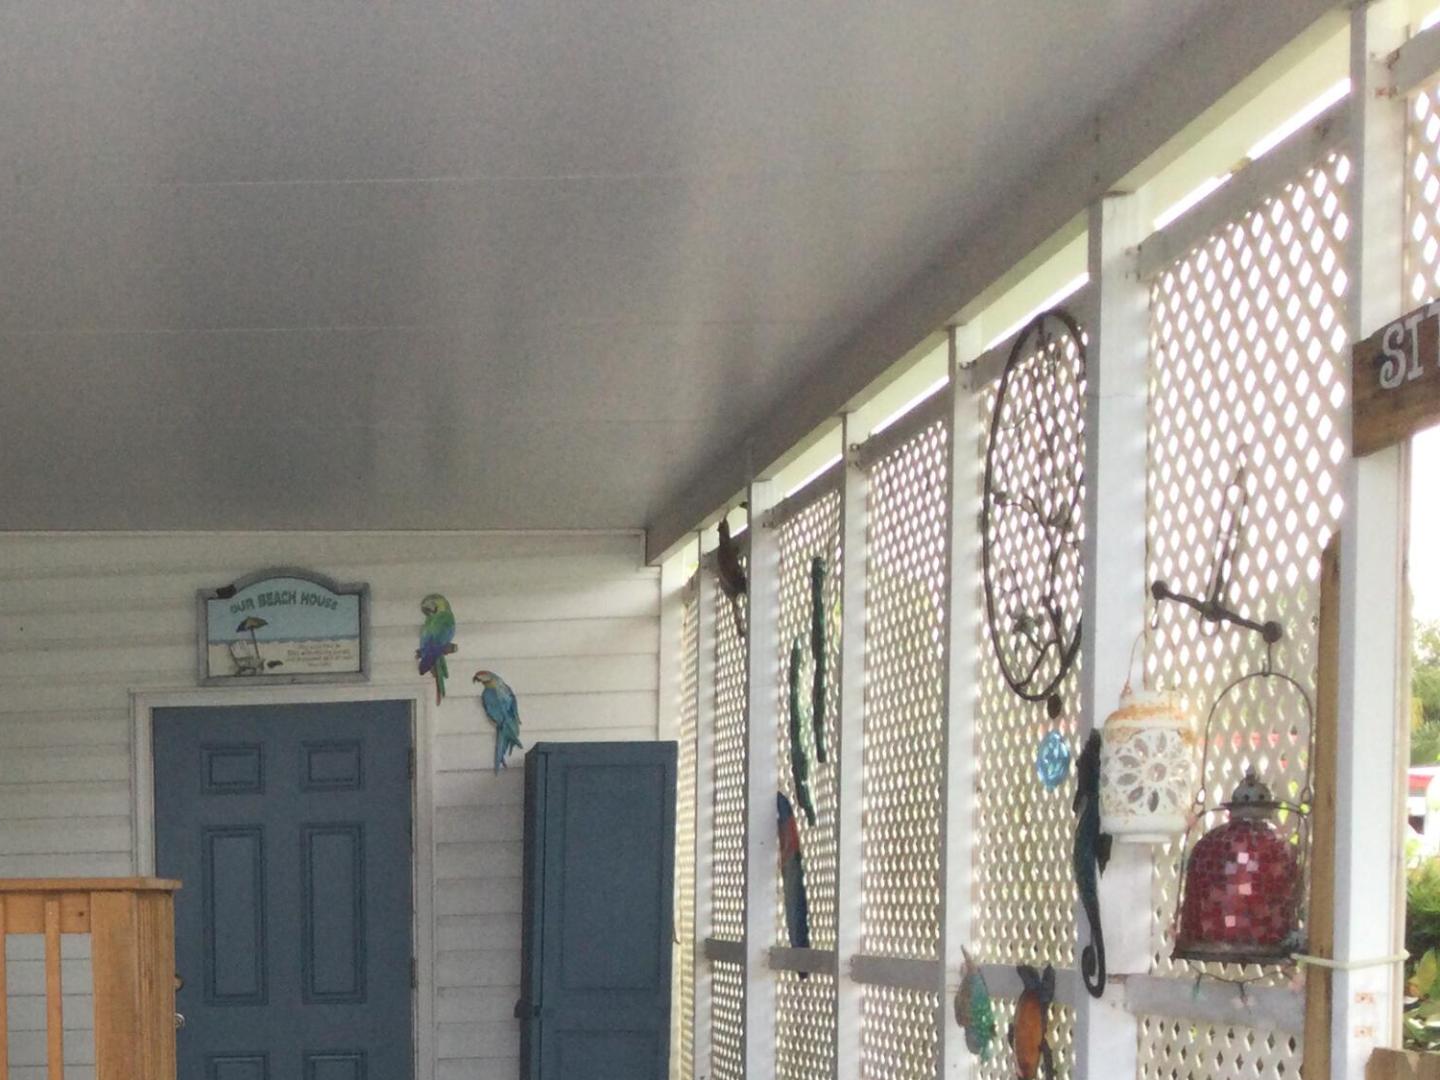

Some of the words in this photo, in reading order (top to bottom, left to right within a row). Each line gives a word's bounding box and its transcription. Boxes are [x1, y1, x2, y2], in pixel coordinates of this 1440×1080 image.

[230, 597, 255, 614] OUR
[257, 590, 297, 608] BEACH
[300, 592, 339, 610] HOUSE
